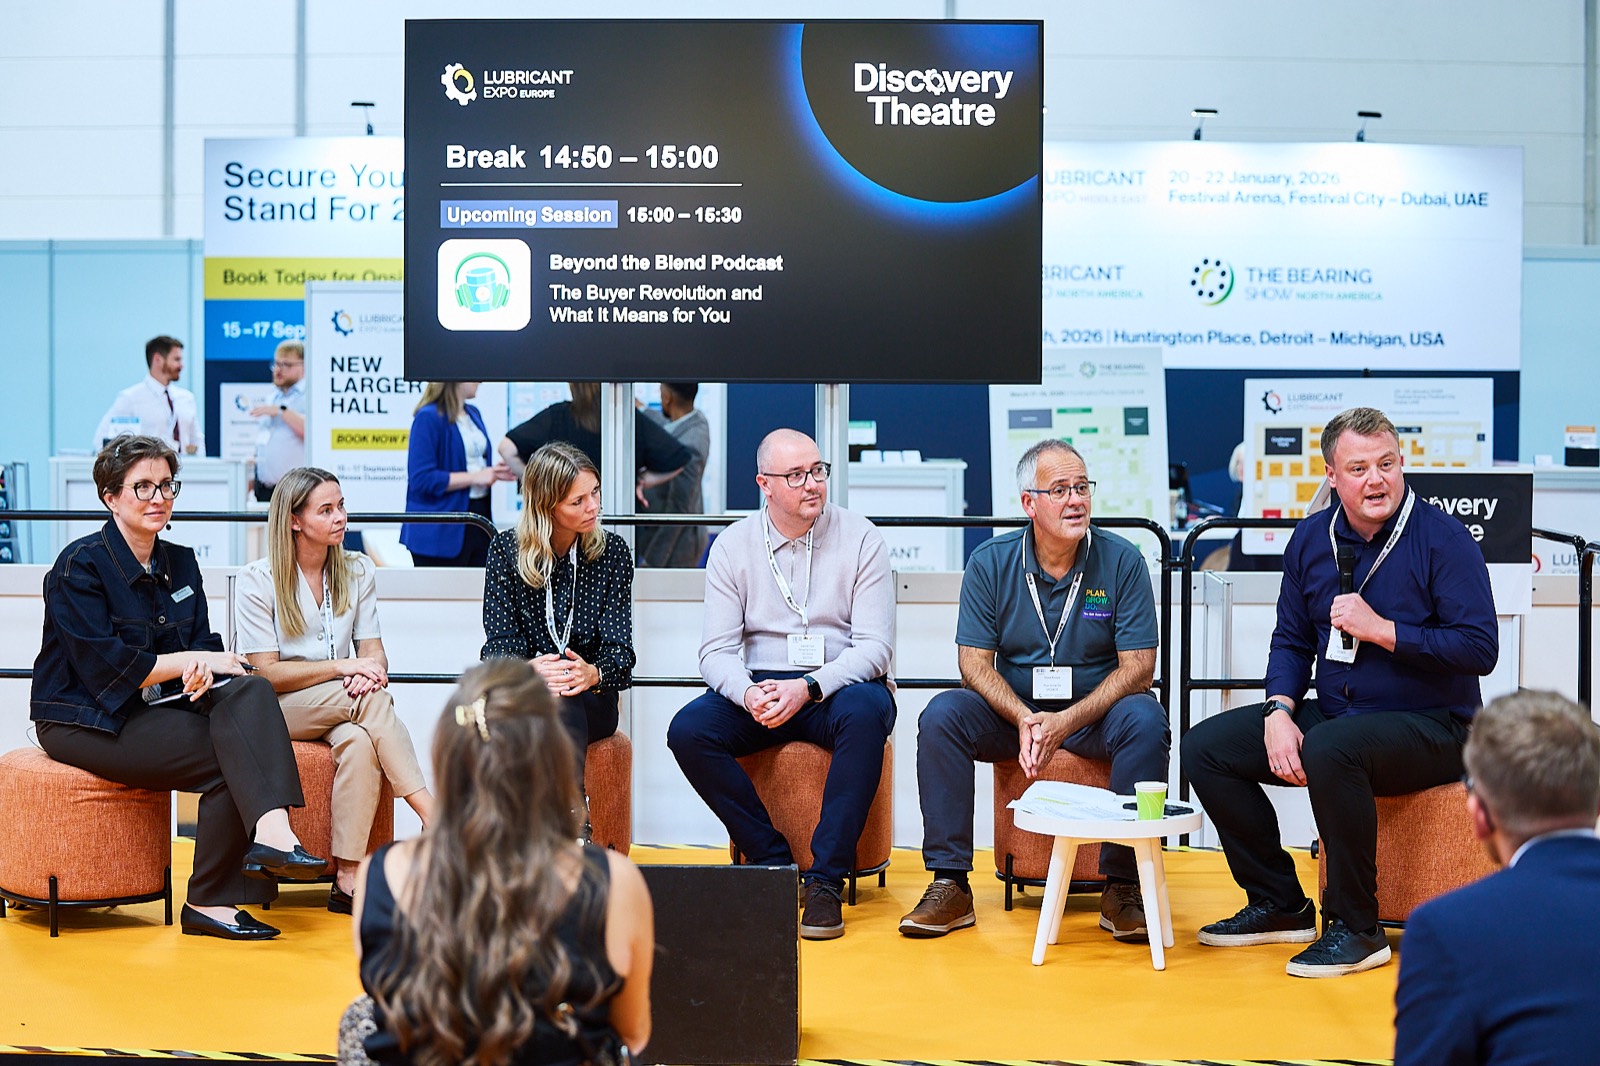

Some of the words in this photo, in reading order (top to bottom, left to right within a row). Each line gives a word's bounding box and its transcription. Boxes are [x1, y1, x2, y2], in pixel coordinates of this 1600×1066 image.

[483, 70, 574, 85] LUBRICANT
[854, 62, 1014, 99] Discovery
[483, 86, 518, 99] EXPO
[520, 89, 555, 99] EUROPE
[867, 95, 996, 127] Theatre
[446, 145, 527, 169] Break
[539, 145, 613, 169] 14:50
[645, 145, 719, 169] 15:00
[224, 162, 336, 188] Secure
[1299, 171, 1340, 184] 2026
[1168, 189, 1230, 204] Festival
[1235, 191, 1286, 206] Arena,
[1289, 190, 1350, 205] Festival
[1354, 191, 1386, 207] City
[1401, 191, 1451, 207] Dubai,
[1454, 192, 1489, 207] UAE
[224, 195, 316, 222] Stand
[330, 196, 380, 222] For
[447, 206, 536, 227] Upcoming
[541, 206, 612, 223] Session
[627, 206, 675, 223] 15:00
[695, 206, 742, 223] 15:30
[550, 254, 618, 274] Beyond
[621, 254, 650, 271] the
[655, 254, 706, 271] Blend
[711, 254, 784, 271] Podcast
[223, 269, 268, 285] Book
[1246, 267, 1283, 283] THE
[1287, 268, 1373, 284] BEARING
[550, 284, 582, 301] The
[586, 284, 635, 305] Buyer
[639, 284, 728, 301] Revolution
[731, 284, 763, 301] and
[1245, 287, 1294, 300] SHOW
[550, 307, 593, 324] What
[598, 307, 609, 324] It
[612, 307, 669, 324] Means
[672, 307, 695, 324] for
[699, 307, 731, 324] You
[1062, 329, 1103, 343] 2026
[1114, 330, 1203, 347] Huntington
[1207, 331, 1256, 347] Place,
[1259, 331, 1314, 345] Detroit
[1330, 331, 1407, 349] Michigan,
[1409, 332, 1445, 346] USA
[330, 356, 382, 373] NEW
[330, 377, 422, 394] LARGER
[330, 397, 388, 414] HALL
[337, 434, 369, 444] BOOK
[372, 434, 399, 444] NOW
